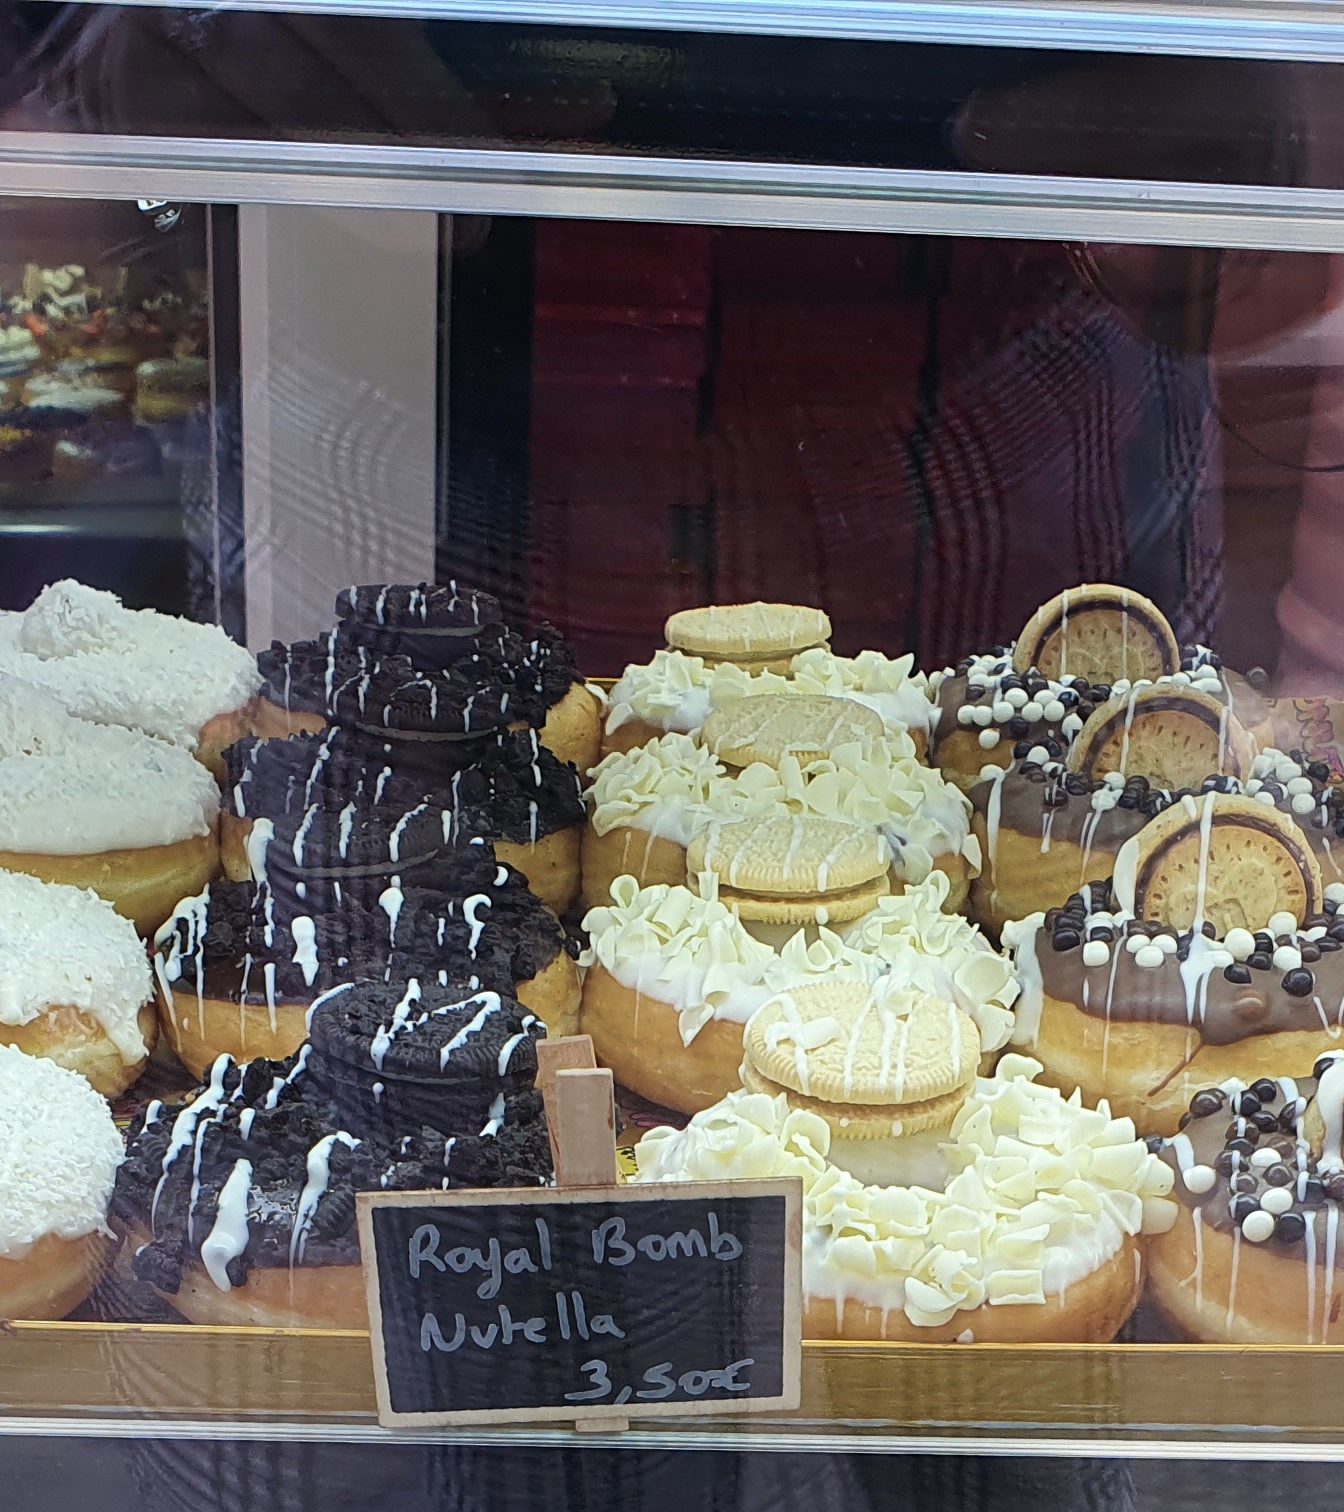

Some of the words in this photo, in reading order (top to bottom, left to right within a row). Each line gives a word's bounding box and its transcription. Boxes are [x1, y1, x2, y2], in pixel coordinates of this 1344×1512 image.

[408, 1217, 552, 1298] Royal
[592, 1212, 744, 1266] Bomb
[420, 1290, 626, 1353] Nutella
